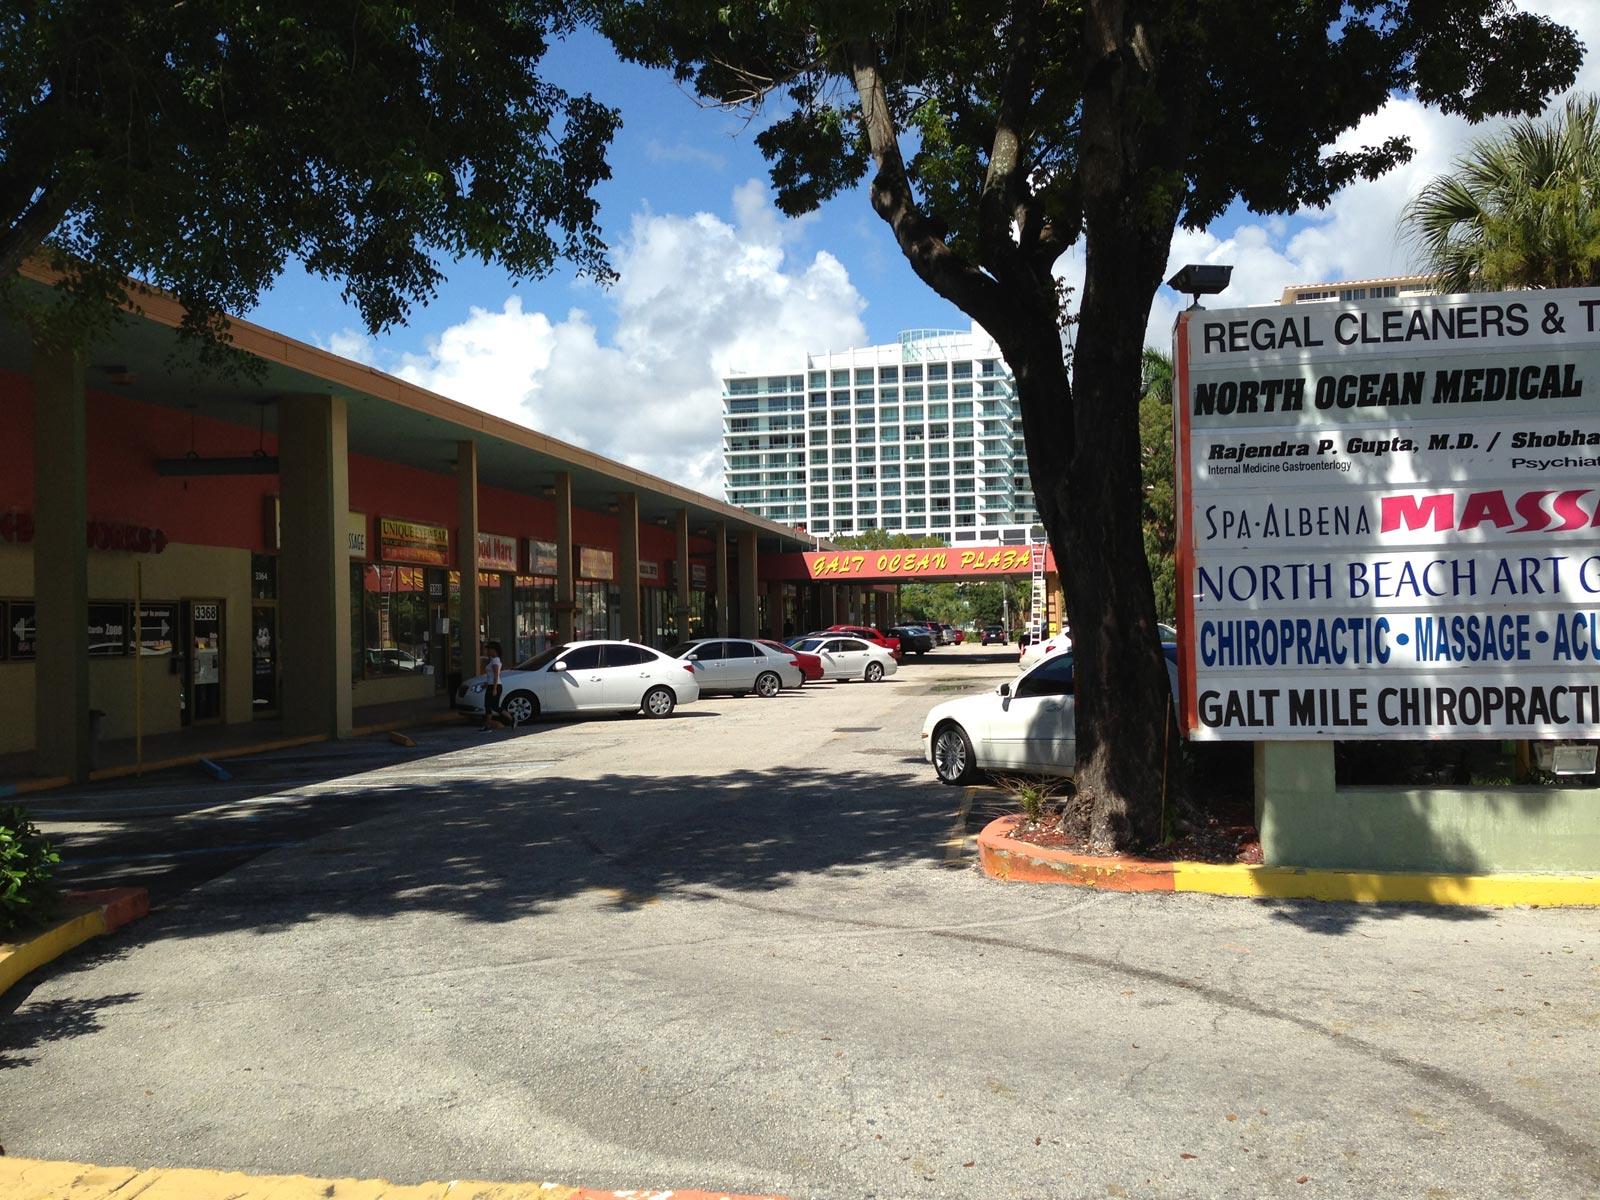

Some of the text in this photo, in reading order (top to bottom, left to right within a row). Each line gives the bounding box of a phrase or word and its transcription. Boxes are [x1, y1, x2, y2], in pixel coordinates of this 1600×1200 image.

[1204, 300, 1600, 355] REGAL CLEANERS & T
[1194, 364, 1583, 416] NORTH OCEAN MEDICAL
[1208, 438, 1310, 463] Rajendra
[1317, 438, 1338, 456] P.
[1346, 436, 1419, 457] Gupta,
[1427, 432, 1479, 452] M.D.
[1511, 429, 1600, 450] Shobha
[1208, 459, 1352, 475] Internal Medicine Gastroenterlogy
[1511, 455, 1600, 470] Psychiat
[1380, 489, 1600, 534] MASS
[383, 521, 413, 540] UNIQUE
[813, 549, 1031, 577] GALT OCEAN PLAZA
[1197, 562, 1332, 603] NORTH
[1349, 557, 1477, 600] BEACH
[1490, 556, 1569, 597] ART
[196, 606, 216, 619] 3368
[105, 623, 123, 635] Zone
[1198, 685, 1600, 728] GALT MILE CHIROPRACTI
